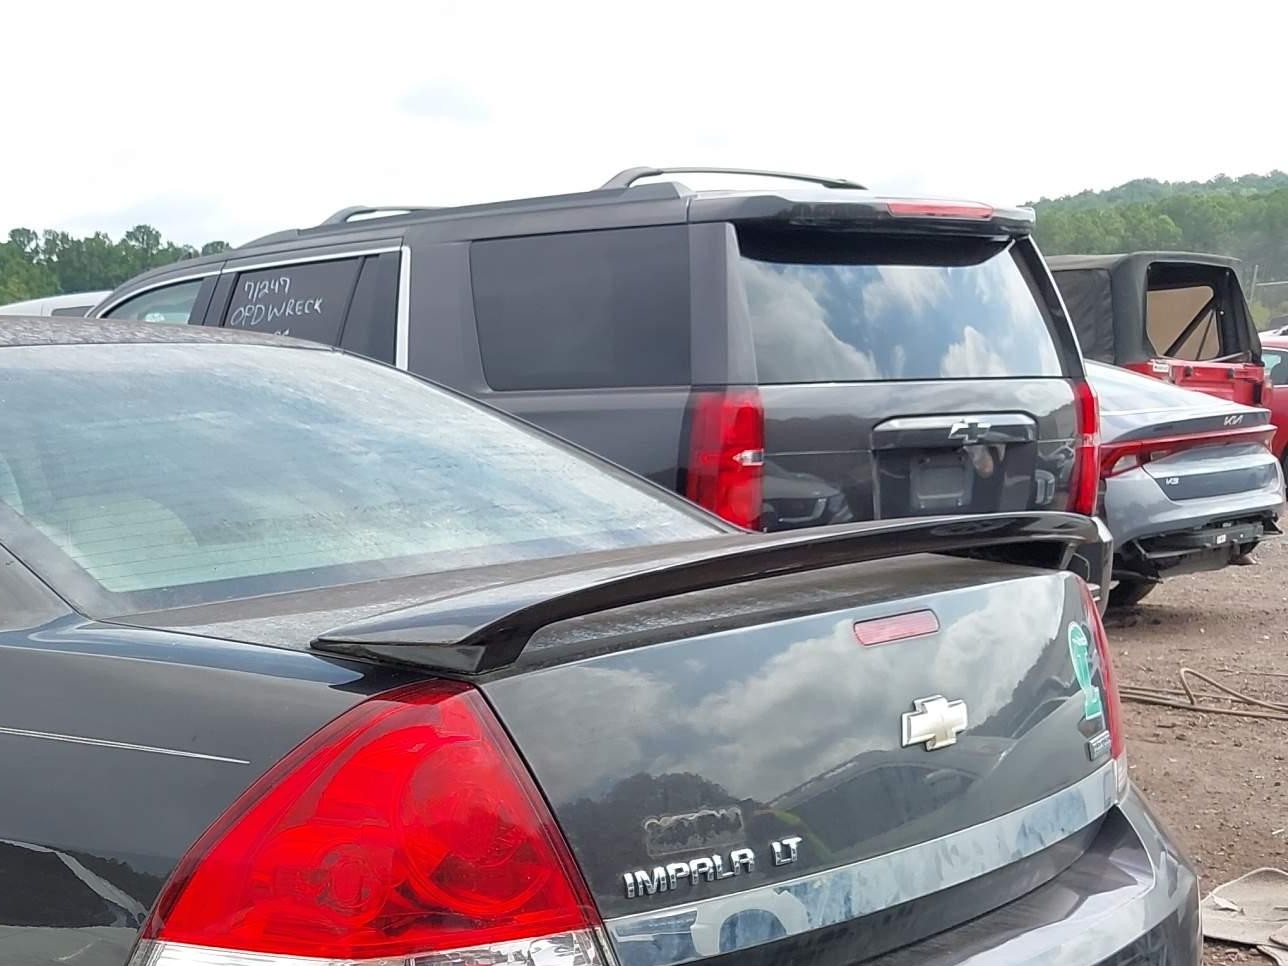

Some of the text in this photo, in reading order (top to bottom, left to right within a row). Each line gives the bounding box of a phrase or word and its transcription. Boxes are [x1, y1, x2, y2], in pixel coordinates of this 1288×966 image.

[267, 297, 323, 323] WRECK
[623, 836, 803, 899] IMPALA LT
